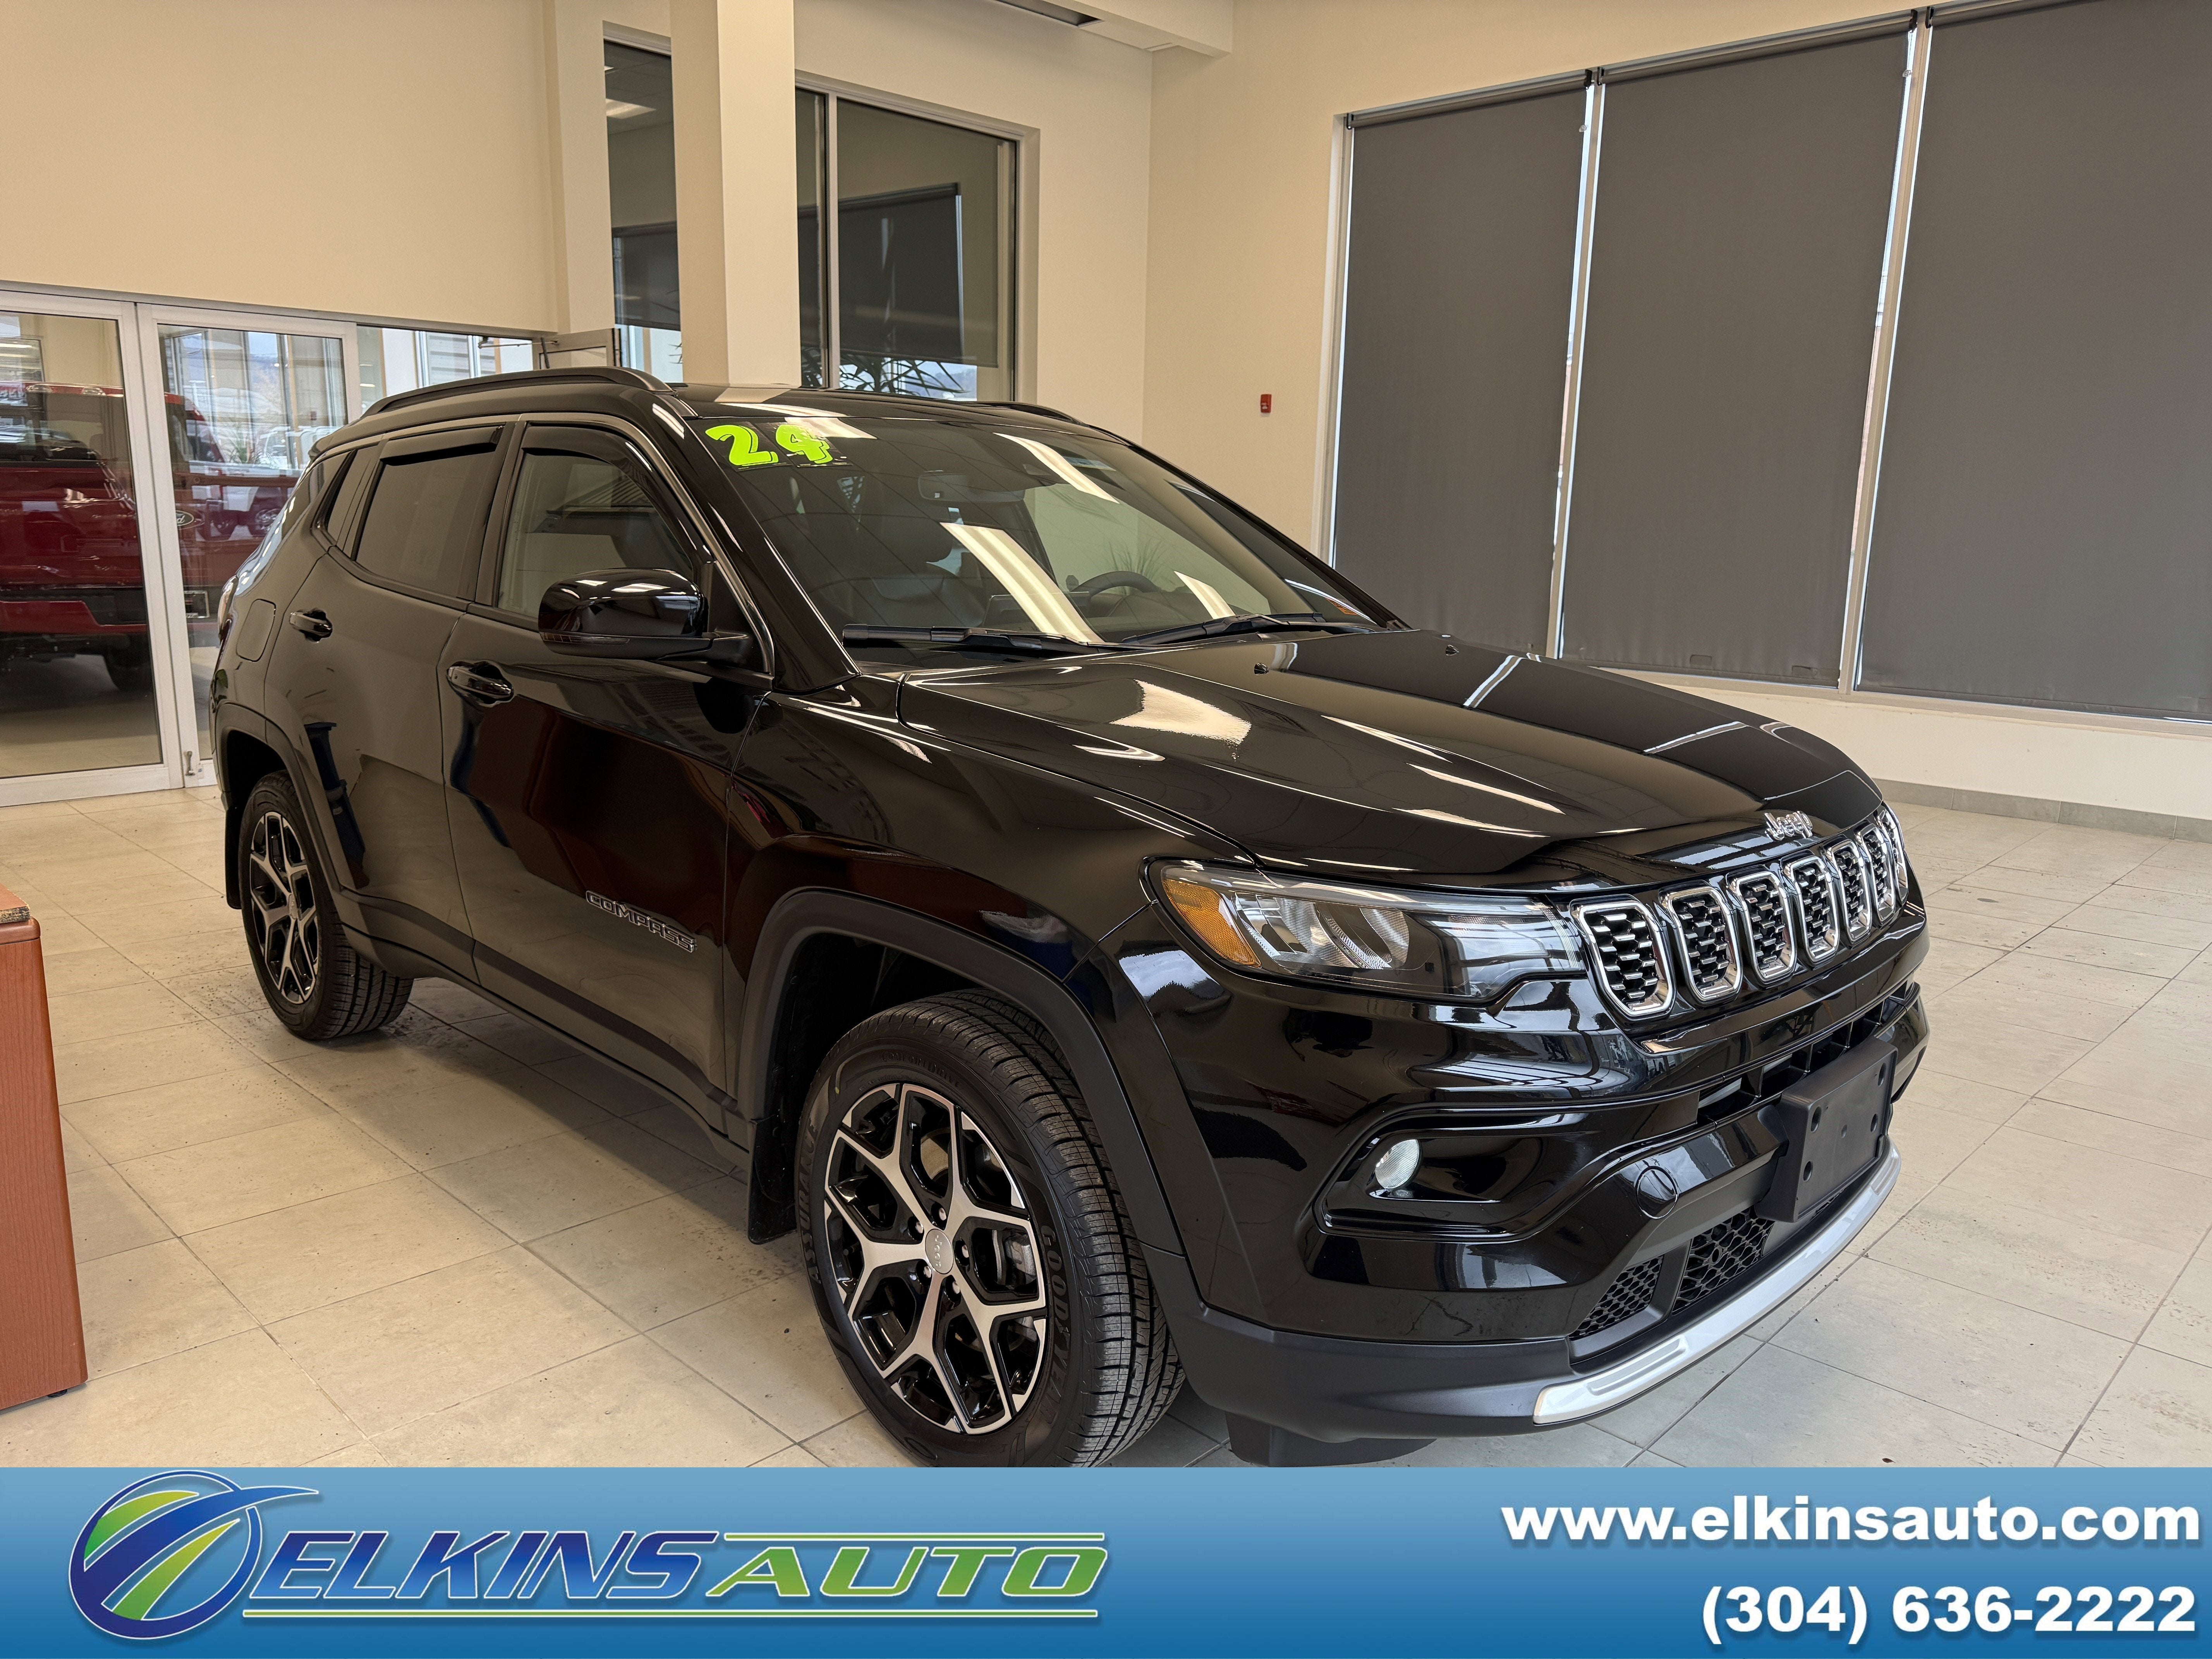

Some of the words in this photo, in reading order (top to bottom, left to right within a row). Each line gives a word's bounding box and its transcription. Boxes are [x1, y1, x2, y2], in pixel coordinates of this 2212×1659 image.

[705, 424, 833, 465] 24
[1764, 811, 1813, 841] Jeep
[586, 890, 697, 953] COMPASS
[934, 1235, 943, 1268] Jeep
[1039, 1225, 1070, 1424] GOODYEAR
